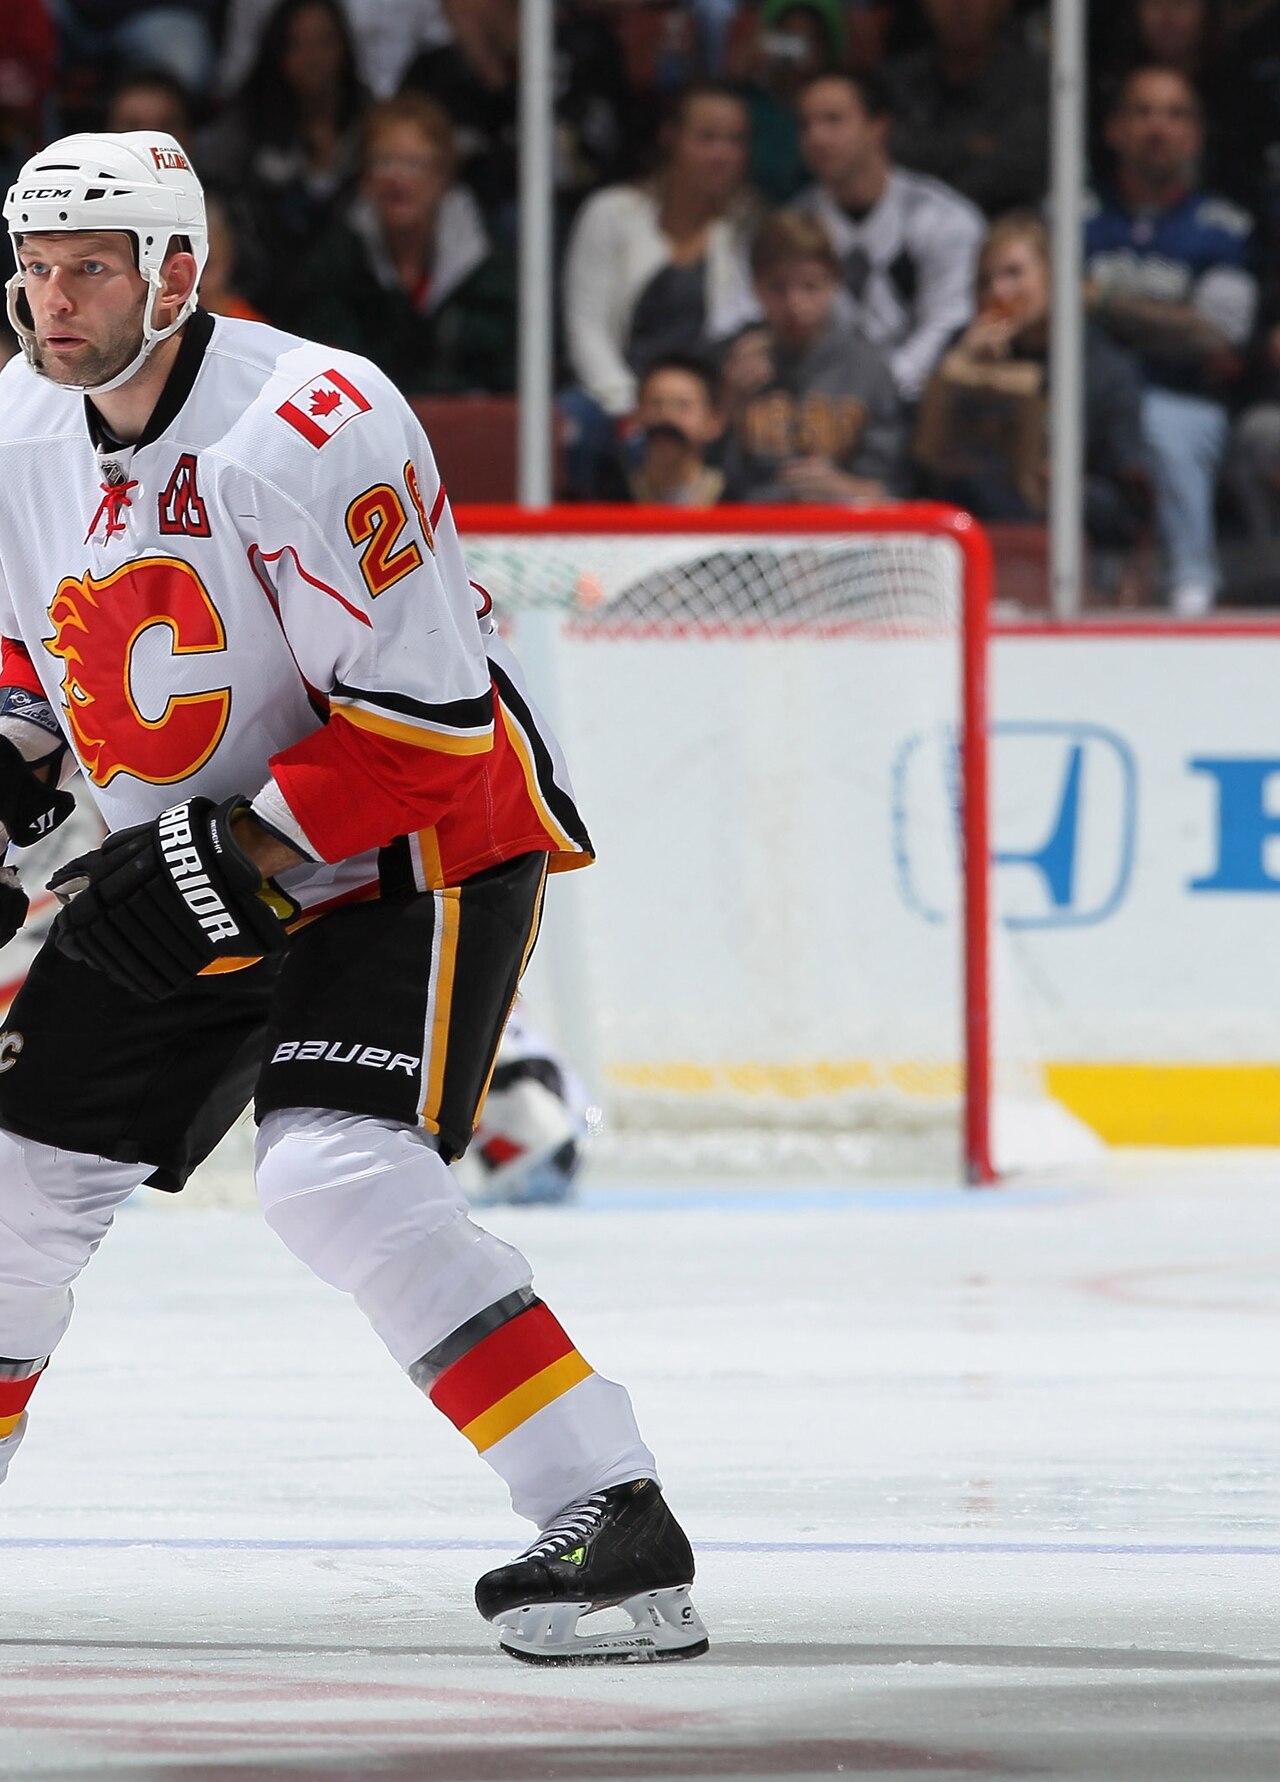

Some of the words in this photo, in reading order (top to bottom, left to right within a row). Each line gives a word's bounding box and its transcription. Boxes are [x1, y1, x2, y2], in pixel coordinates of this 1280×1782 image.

[22, 189, 72, 200] CCM
[158, 796, 240, 944] ARRIOR
[270, 1040, 420, 1076] BAUER
